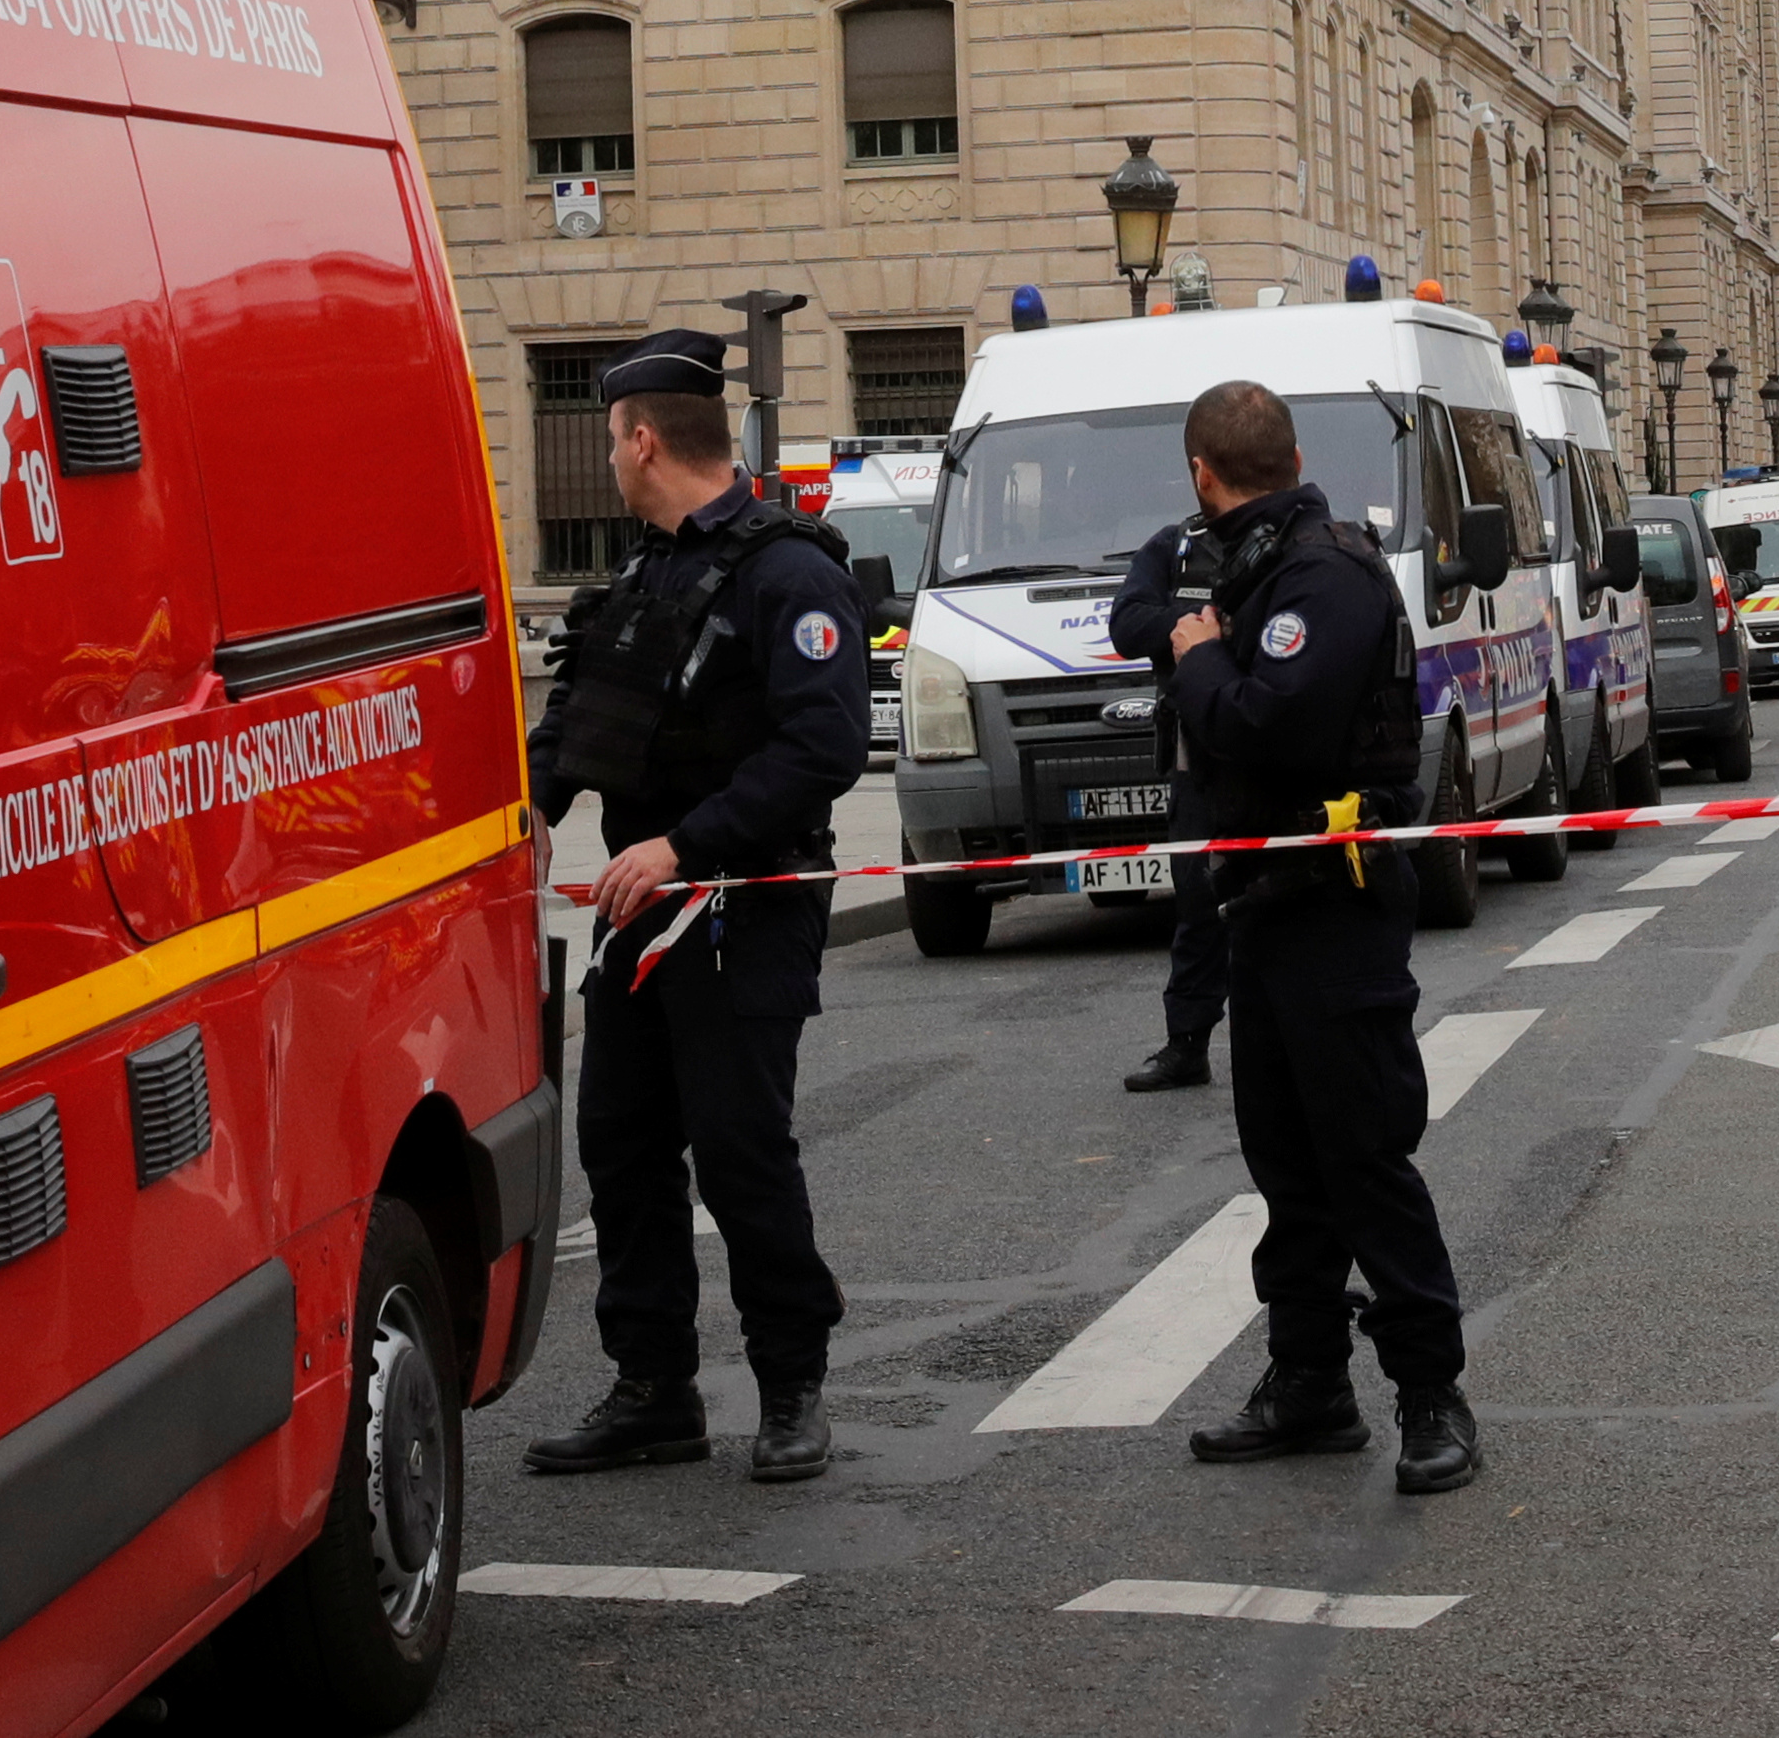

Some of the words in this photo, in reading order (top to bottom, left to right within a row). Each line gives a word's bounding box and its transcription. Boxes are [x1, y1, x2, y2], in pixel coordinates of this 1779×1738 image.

[18, 449, 56, 544] 18
[58, 774, 90, 856] DE
[91, 750, 170, 847] SECOURS
[167, 744, 194, 820] ET
[324, 699, 359, 773] AUX
[356, 683, 421, 763] VICTIMES
